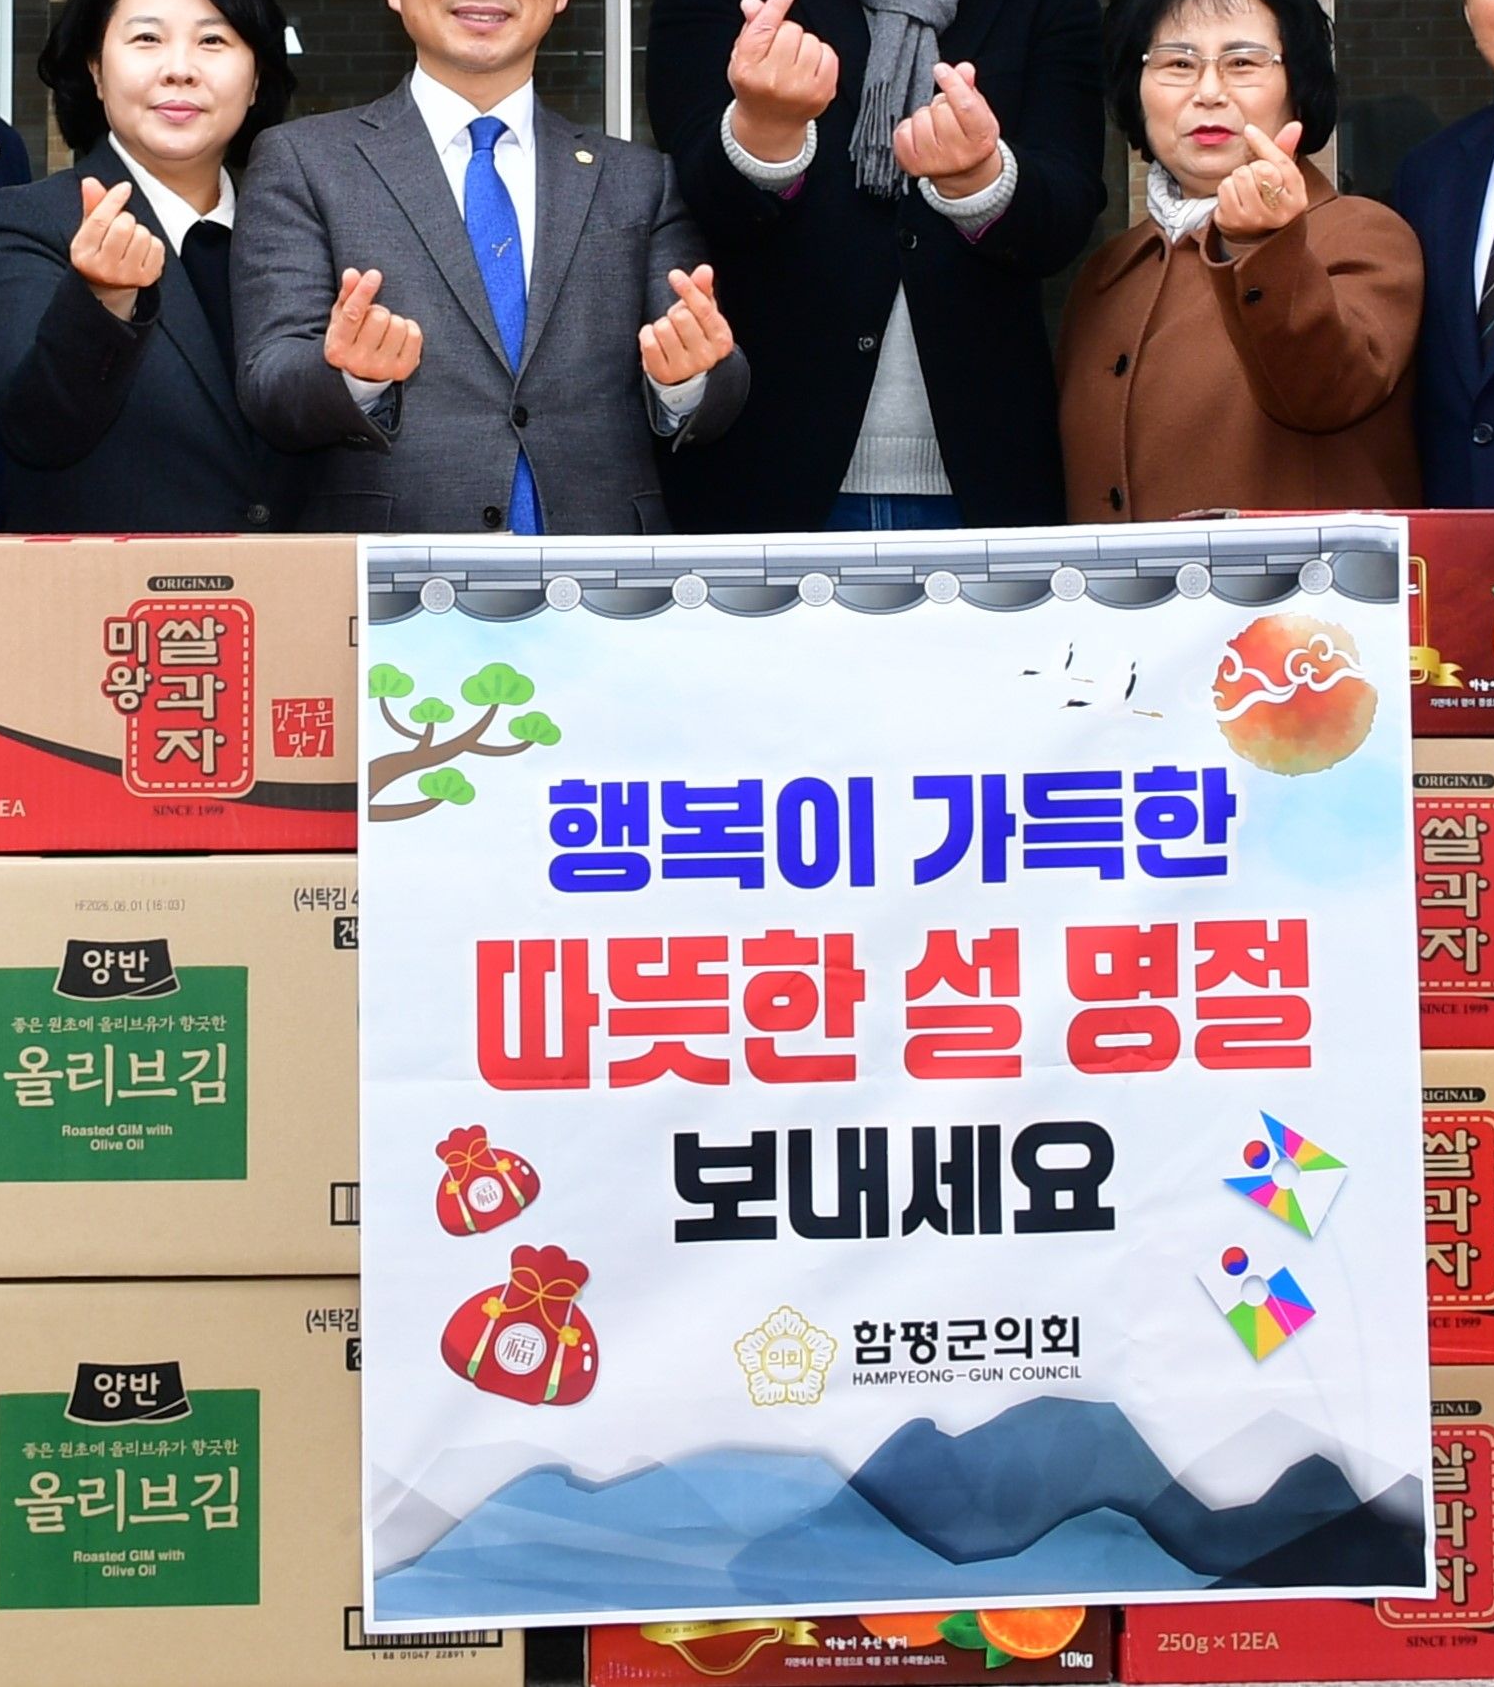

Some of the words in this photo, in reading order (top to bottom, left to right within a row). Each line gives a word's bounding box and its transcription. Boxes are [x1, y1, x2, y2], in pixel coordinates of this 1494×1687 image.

[156, 577, 225, 590] ORIGINAL
[104, 618, 153, 712] 미왕
[154, 614, 228, 775] 쌀과자
[1418, 775, 1488, 789] ORIGINAL
[153, 805, 190, 816] SINCE
[198, 805, 224, 816] 1999
[549, 777, 875, 893] 행복이
[913, 766, 1237, 884] 가득한
[294, 887, 346, 912] (식탁김
[1420, 815, 1490, 974] 쌀과자
[82, 949, 149, 983] 양반
[476, 927, 866, 1090] 따뜻한
[904, 927, 1023, 1080] 설
[1066, 918, 1312, 1075] 명절
[11, 1016, 43, 1033] 좋은
[180, 1016, 227, 1033] 향긋한
[3, 1043, 228, 1107] 올리브김
[1422, 1088, 1478, 1101] RIGINAL
[62, 1125, 114, 1137] Roasted
[117, 1125, 143, 1136] GIM
[147, 1125, 173, 1136] with
[90, 1139, 123, 1151] Olive
[126, 1139, 145, 1151] Oil
[673, 1121, 1117, 1244] 보내세요
[306, 1308, 359, 1334] (식탁김
[853, 1315, 1080, 1365] 함평군의회
[768, 1348, 804, 1370] 의회
[1009, 1365, 1082, 1381] COUNCIL
[94, 1370, 160, 1408] 양반
[1431, 1401, 1474, 1415] GINAL
[22, 1441, 53, 1459] 좋은
[192, 1438, 239, 1456] 향긋한
[14, 1466, 240, 1533] 올리브김
[73, 1550, 126, 1563] Roasted
[129, 1550, 155, 1562] GIM
[158, 1549, 185, 1561] with
[101, 1565, 134, 1577] Olive
[138, 1564, 157, 1576] Oil
[1157, 1632, 1209, 1655] 250g
[1230, 1631, 1280, 1650] 12EA
[1407, 1636, 1447, 1647] SINCE
[1451, 1635, 1478, 1646] 1999
[399, 1651, 430, 1659] 01047
[435, 1650, 465, 1658] 22891
[1058, 1652, 1094, 1670] 10kg
